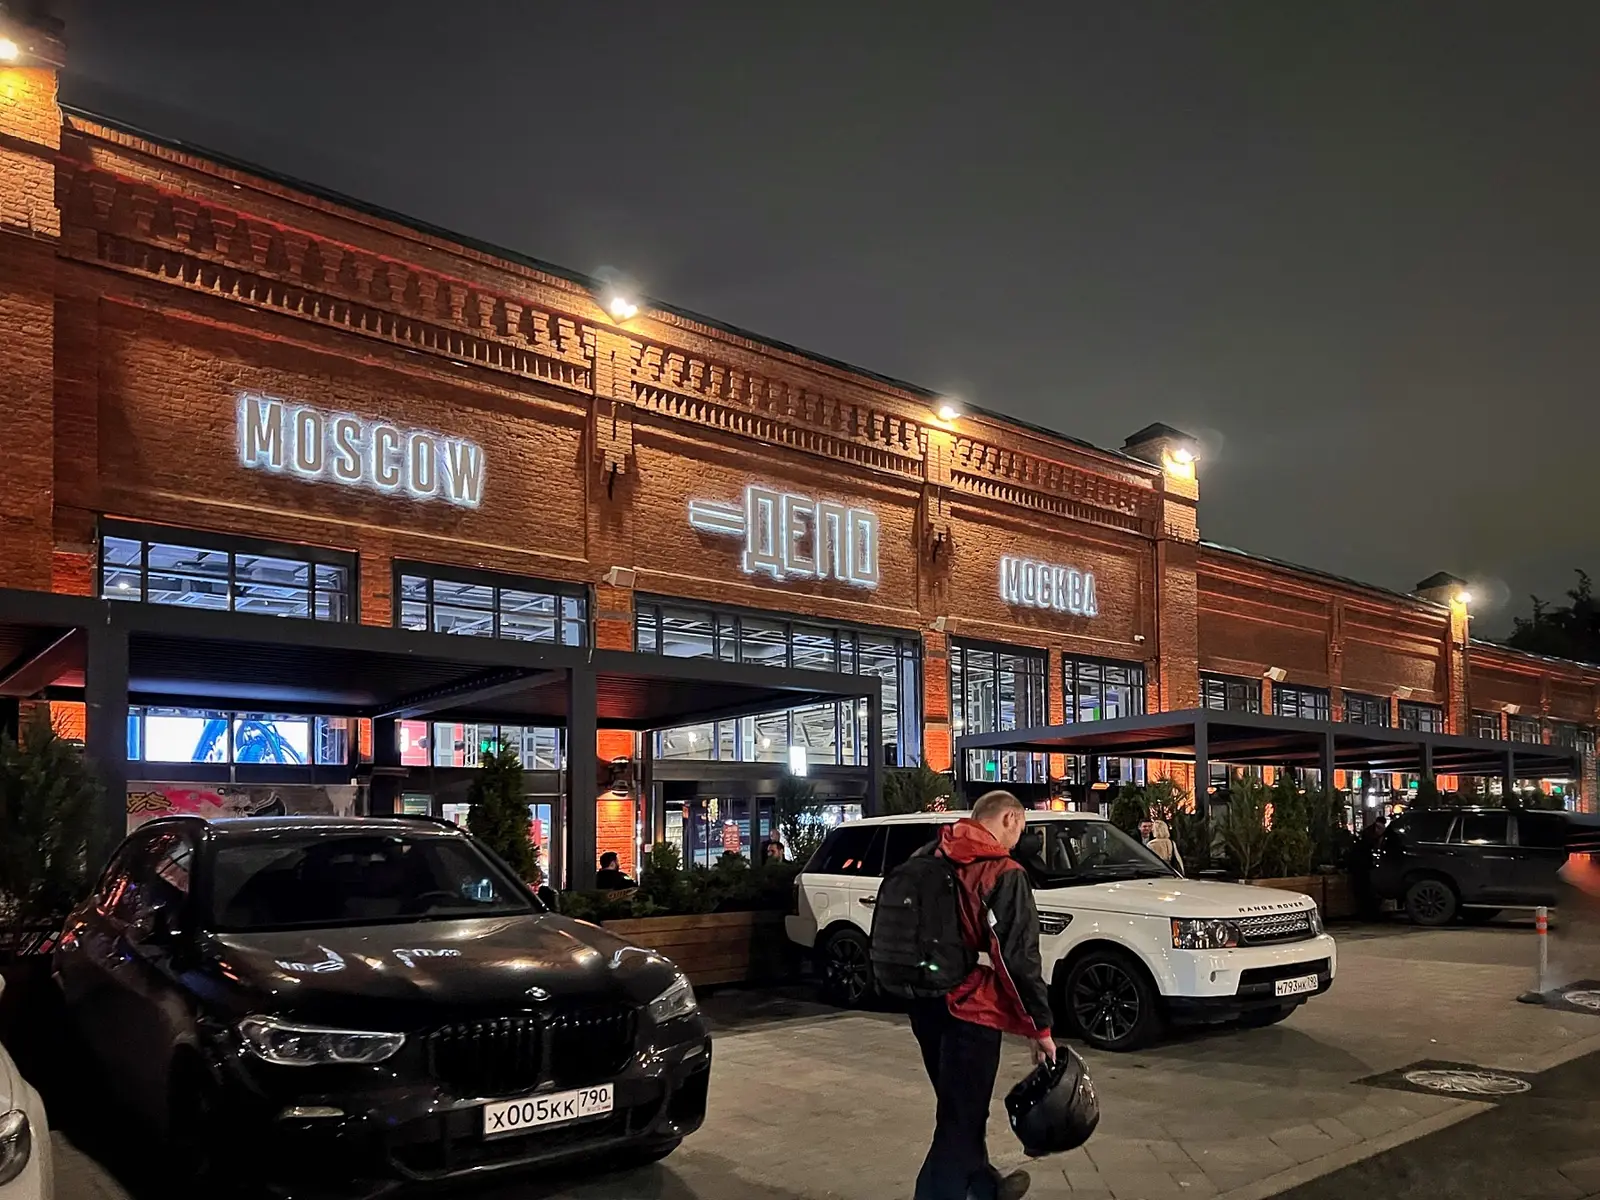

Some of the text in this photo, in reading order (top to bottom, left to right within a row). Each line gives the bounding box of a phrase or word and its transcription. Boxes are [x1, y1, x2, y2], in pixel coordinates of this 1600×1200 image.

[244, 398, 484, 504] MOSCOW
[743, 487, 878, 588] ДЕПО
[1002, 557, 1098, 614] МОСКВА
[1238, 901, 1304, 913] RANGE ROVER
[579, 1087, 609, 1108] 790
